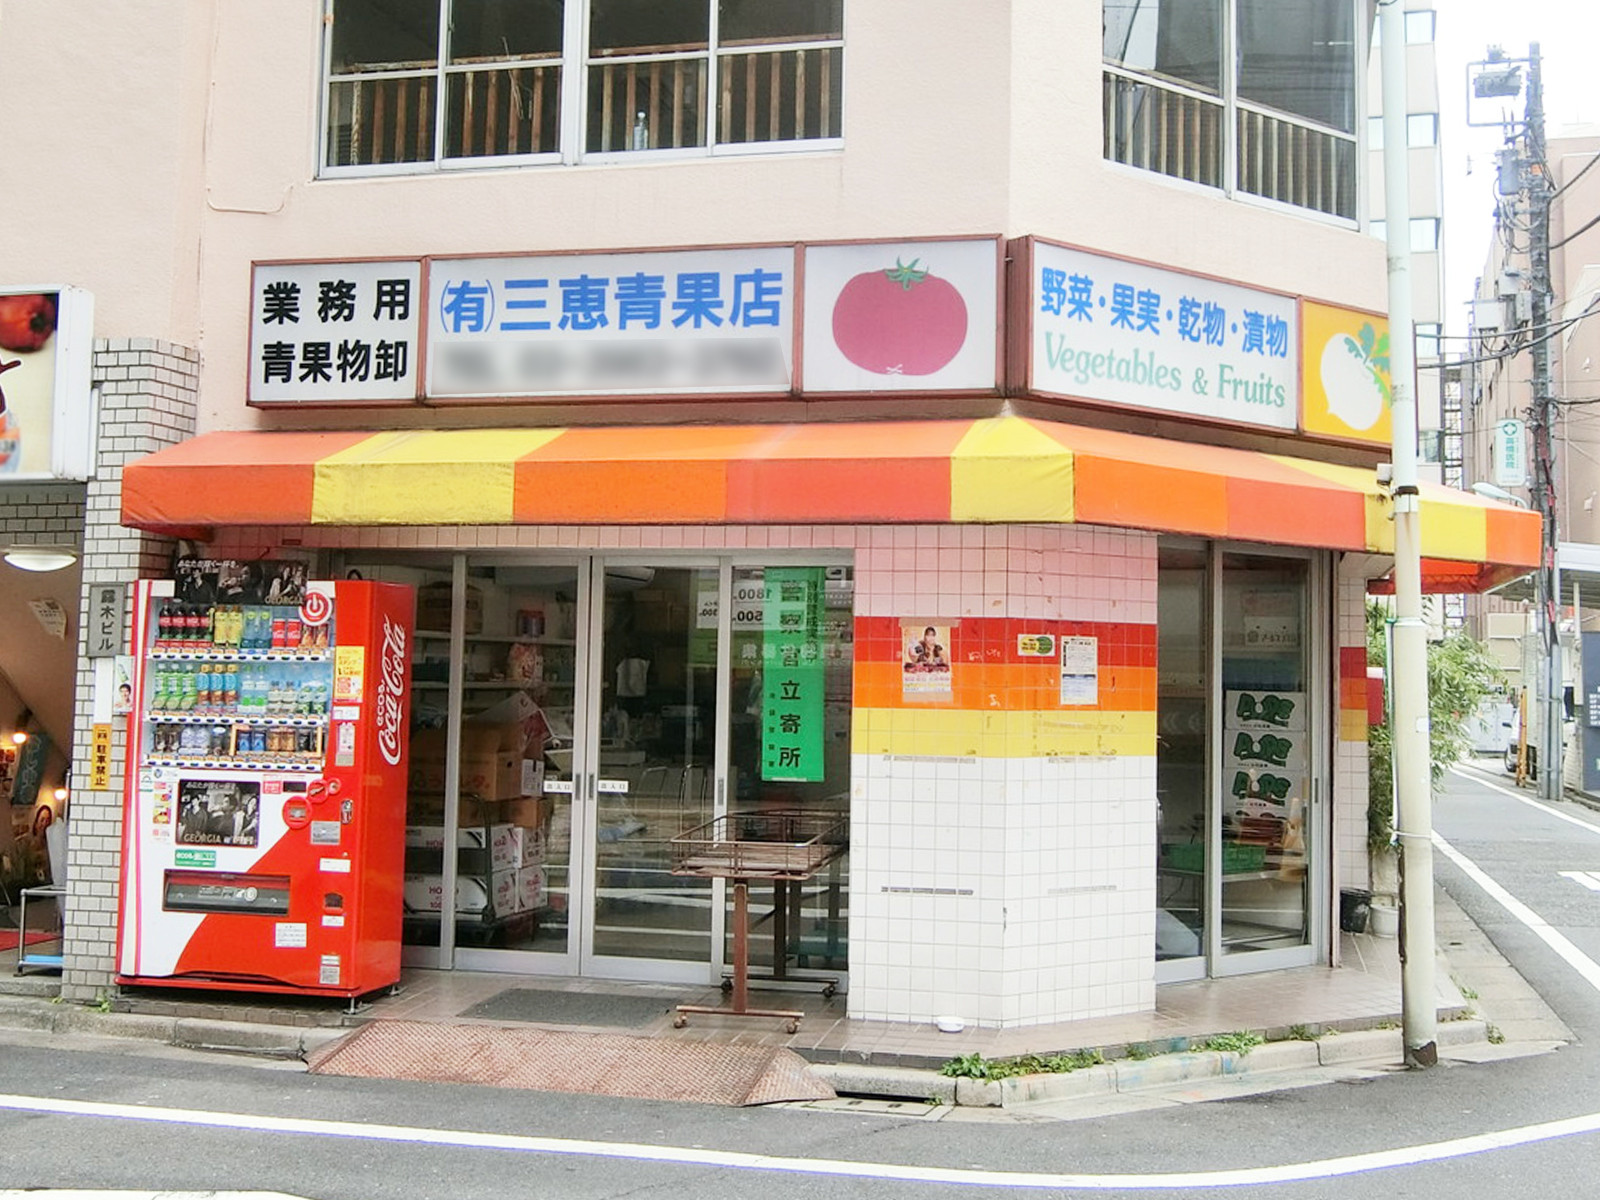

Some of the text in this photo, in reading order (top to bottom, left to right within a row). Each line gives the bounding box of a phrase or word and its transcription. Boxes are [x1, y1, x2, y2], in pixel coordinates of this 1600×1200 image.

[263, 279, 410, 325] 業務用
[261, 339, 408, 384] 青果物卸
[1045, 331, 1286, 408] Vegetables & Fruits
[378, 613, 406, 766] Coca-Cola
[94, 744, 107, 786] 駐車禁止
[183, 832, 222, 844] GEORGIA
